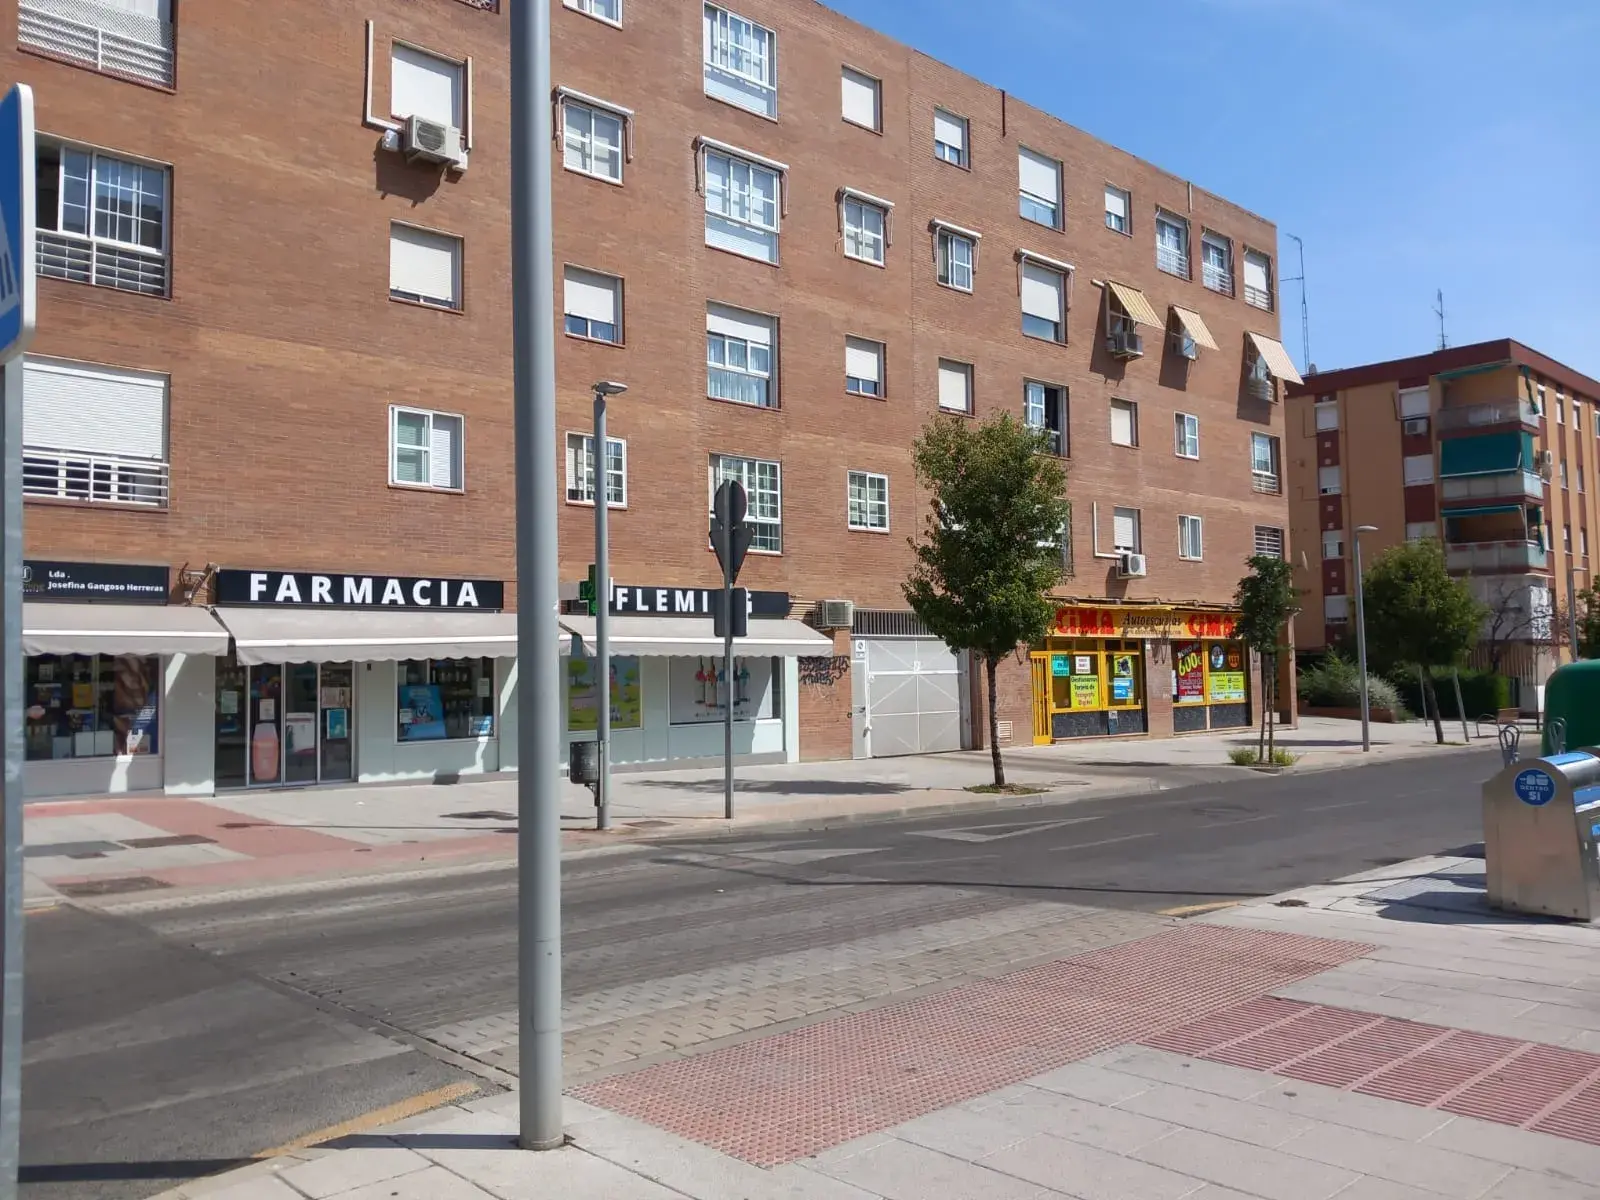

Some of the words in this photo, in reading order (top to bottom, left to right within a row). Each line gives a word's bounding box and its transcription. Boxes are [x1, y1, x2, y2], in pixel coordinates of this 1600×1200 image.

[47, 581, 86, 590] Josefina
[87, 582, 126, 592] Gangoso
[126, 583, 164, 592] Herreras
[250, 573, 479, 607] FARMACIA
[616, 588, 752, 613] FLEMI
